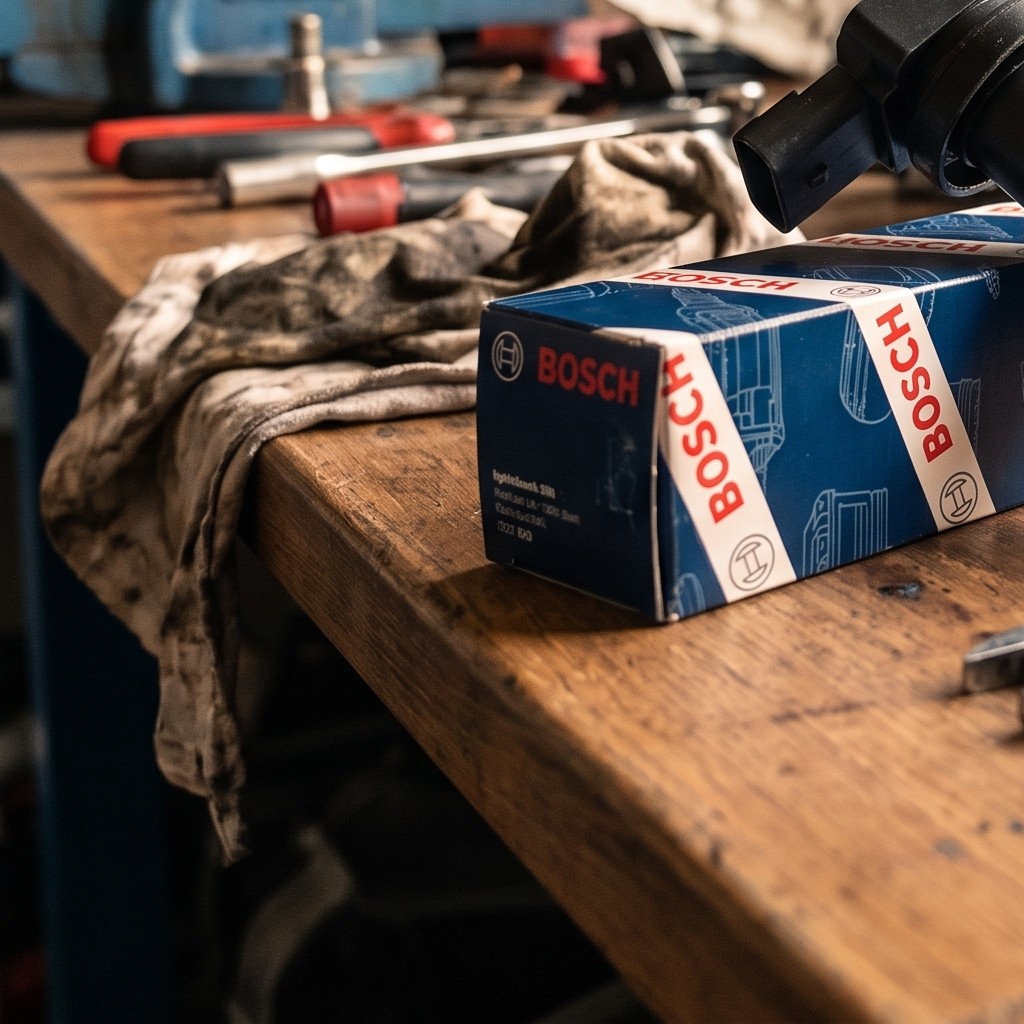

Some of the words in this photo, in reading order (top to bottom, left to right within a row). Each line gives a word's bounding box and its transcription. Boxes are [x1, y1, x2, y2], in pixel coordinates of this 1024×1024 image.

[631, 271, 800, 291] BOSCH
[537, 345, 641, 407] BOSCH
[876, 303, 954, 464] BOSCH
[661, 353, 745, 524] BOSCH
